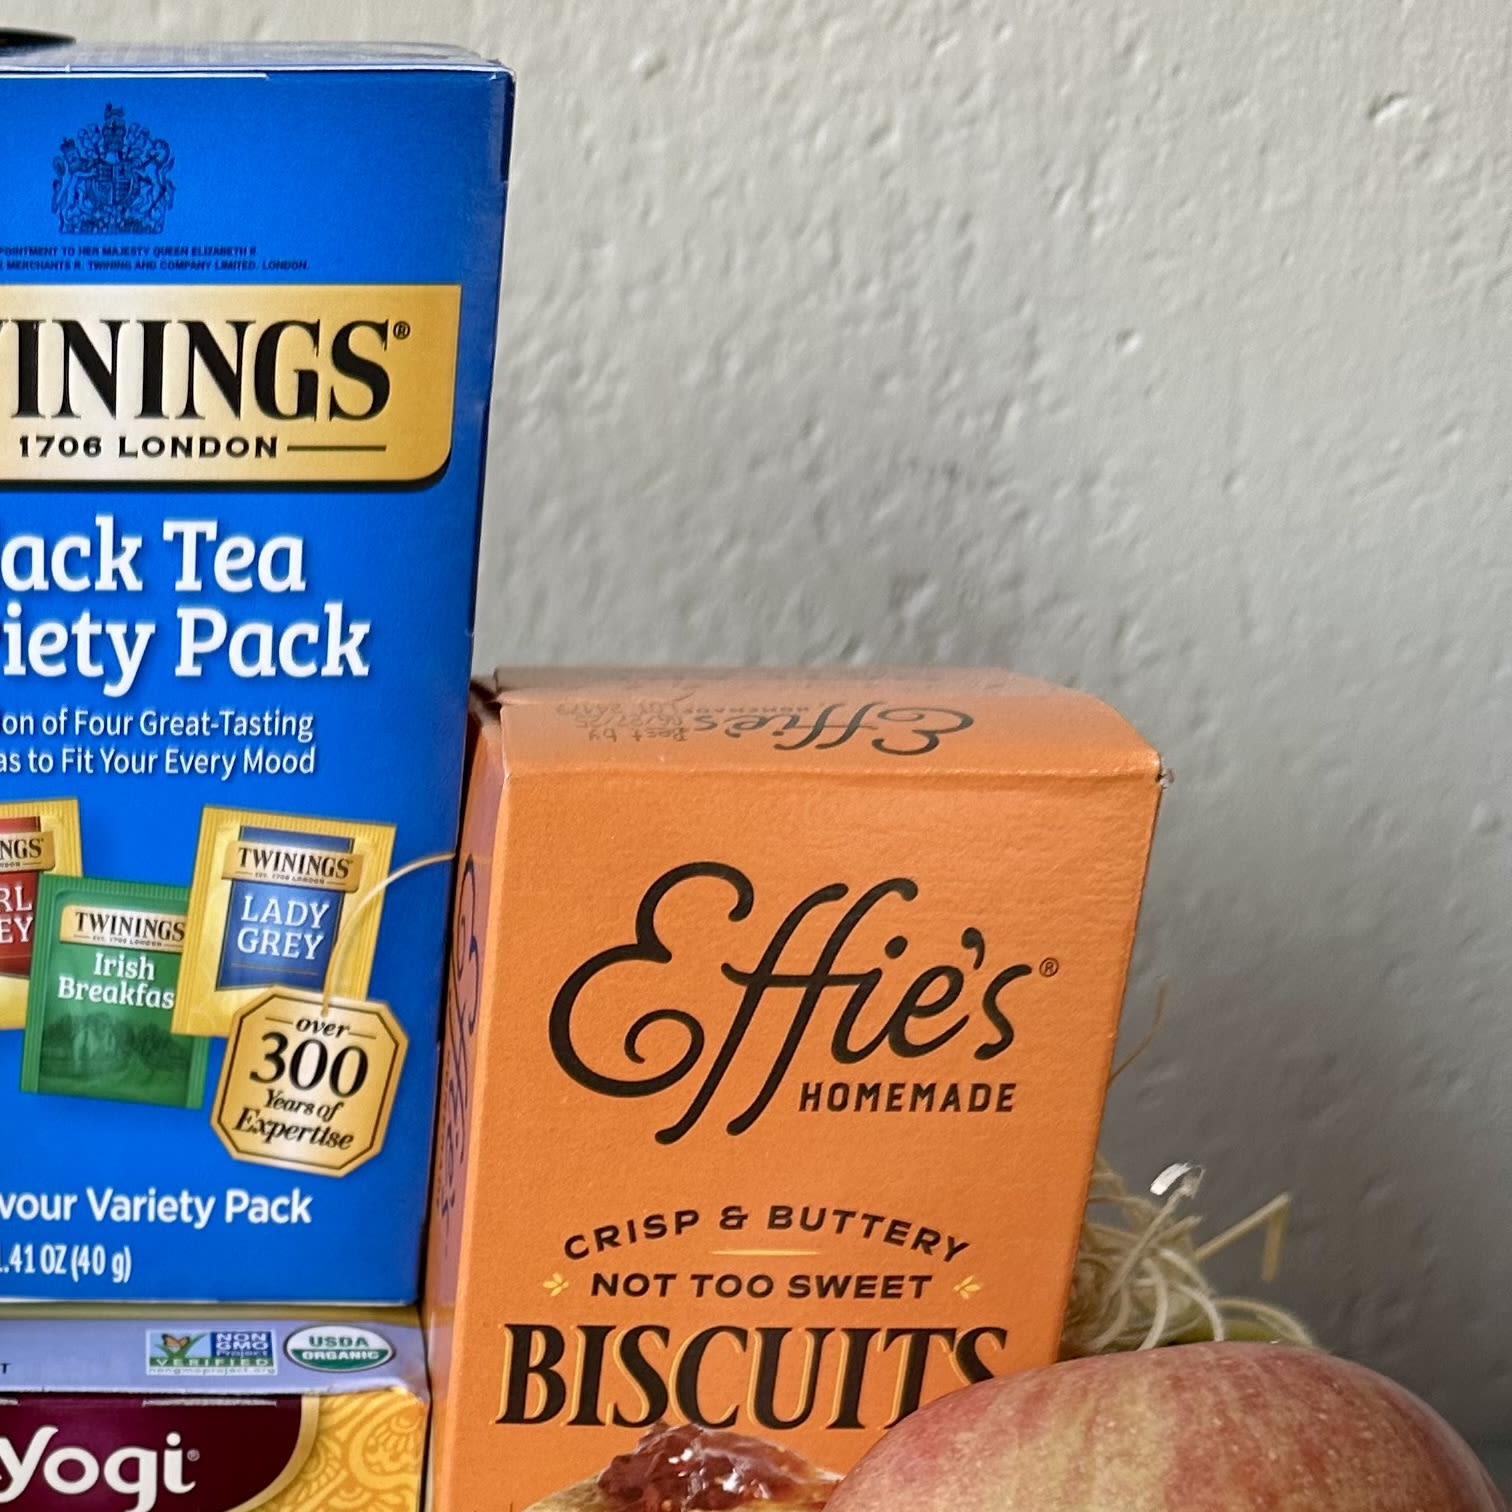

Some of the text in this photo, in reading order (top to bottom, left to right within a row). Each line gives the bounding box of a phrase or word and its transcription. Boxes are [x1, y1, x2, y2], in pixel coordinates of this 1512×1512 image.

[102, 245, 150, 257] MAJESTY
[153, 245, 189, 258] QUEEN
[160, 259, 212, 271] COMPANY
[19, 436, 103, 459] 1706
[118, 436, 279, 460] LONDON
[163, 519, 307, 593] Tea
[175, 600, 371, 678] Pack
[42, 708, 70, 736] of
[74, 711, 133, 737] Four
[139, 709, 315, 743] Great-Tasting
[692, 702, 975, 755] Effie's
[28, 750, 54, 774] to
[61, 747, 94, 774] Fit
[100, 748, 158, 775] Your
[165, 747, 237, 782] Every
[242, 746, 316, 776] Mood
[238, 847, 350, 880] TWININGS
[75, 912, 185, 943] TWININGS
[241, 895, 330, 929] LADY
[237, 928, 325, 960] GREY
[93, 952, 155, 981] Irish
[296, 1018, 351, 1038] over
[249, 1031, 369, 1099] 300
[264, 1088, 345, 1123] Years of
[798, 1081, 1017, 1113] HOMEMADE
[232, 1107, 355, 1150] Expertise
[85, 1188, 217, 1230] Variety
[224, 1188, 313, 1225] Pack
[563, 1204, 971, 1263] CRISP & BUTTERY
[40, 1245, 68, 1276] OZ
[590, 1272, 933, 1300] NOT TOO SWEET
[215, 1332, 267, 1342] NON
[215, 1341, 269, 1351] GMO
[308, 1335, 369, 1348] USDA
[156, 1357, 270, 1367] VERIFIED
[301, 1350, 380, 1361] ORGANIC
[495, 1323, 1008, 1431] BISCUITS
